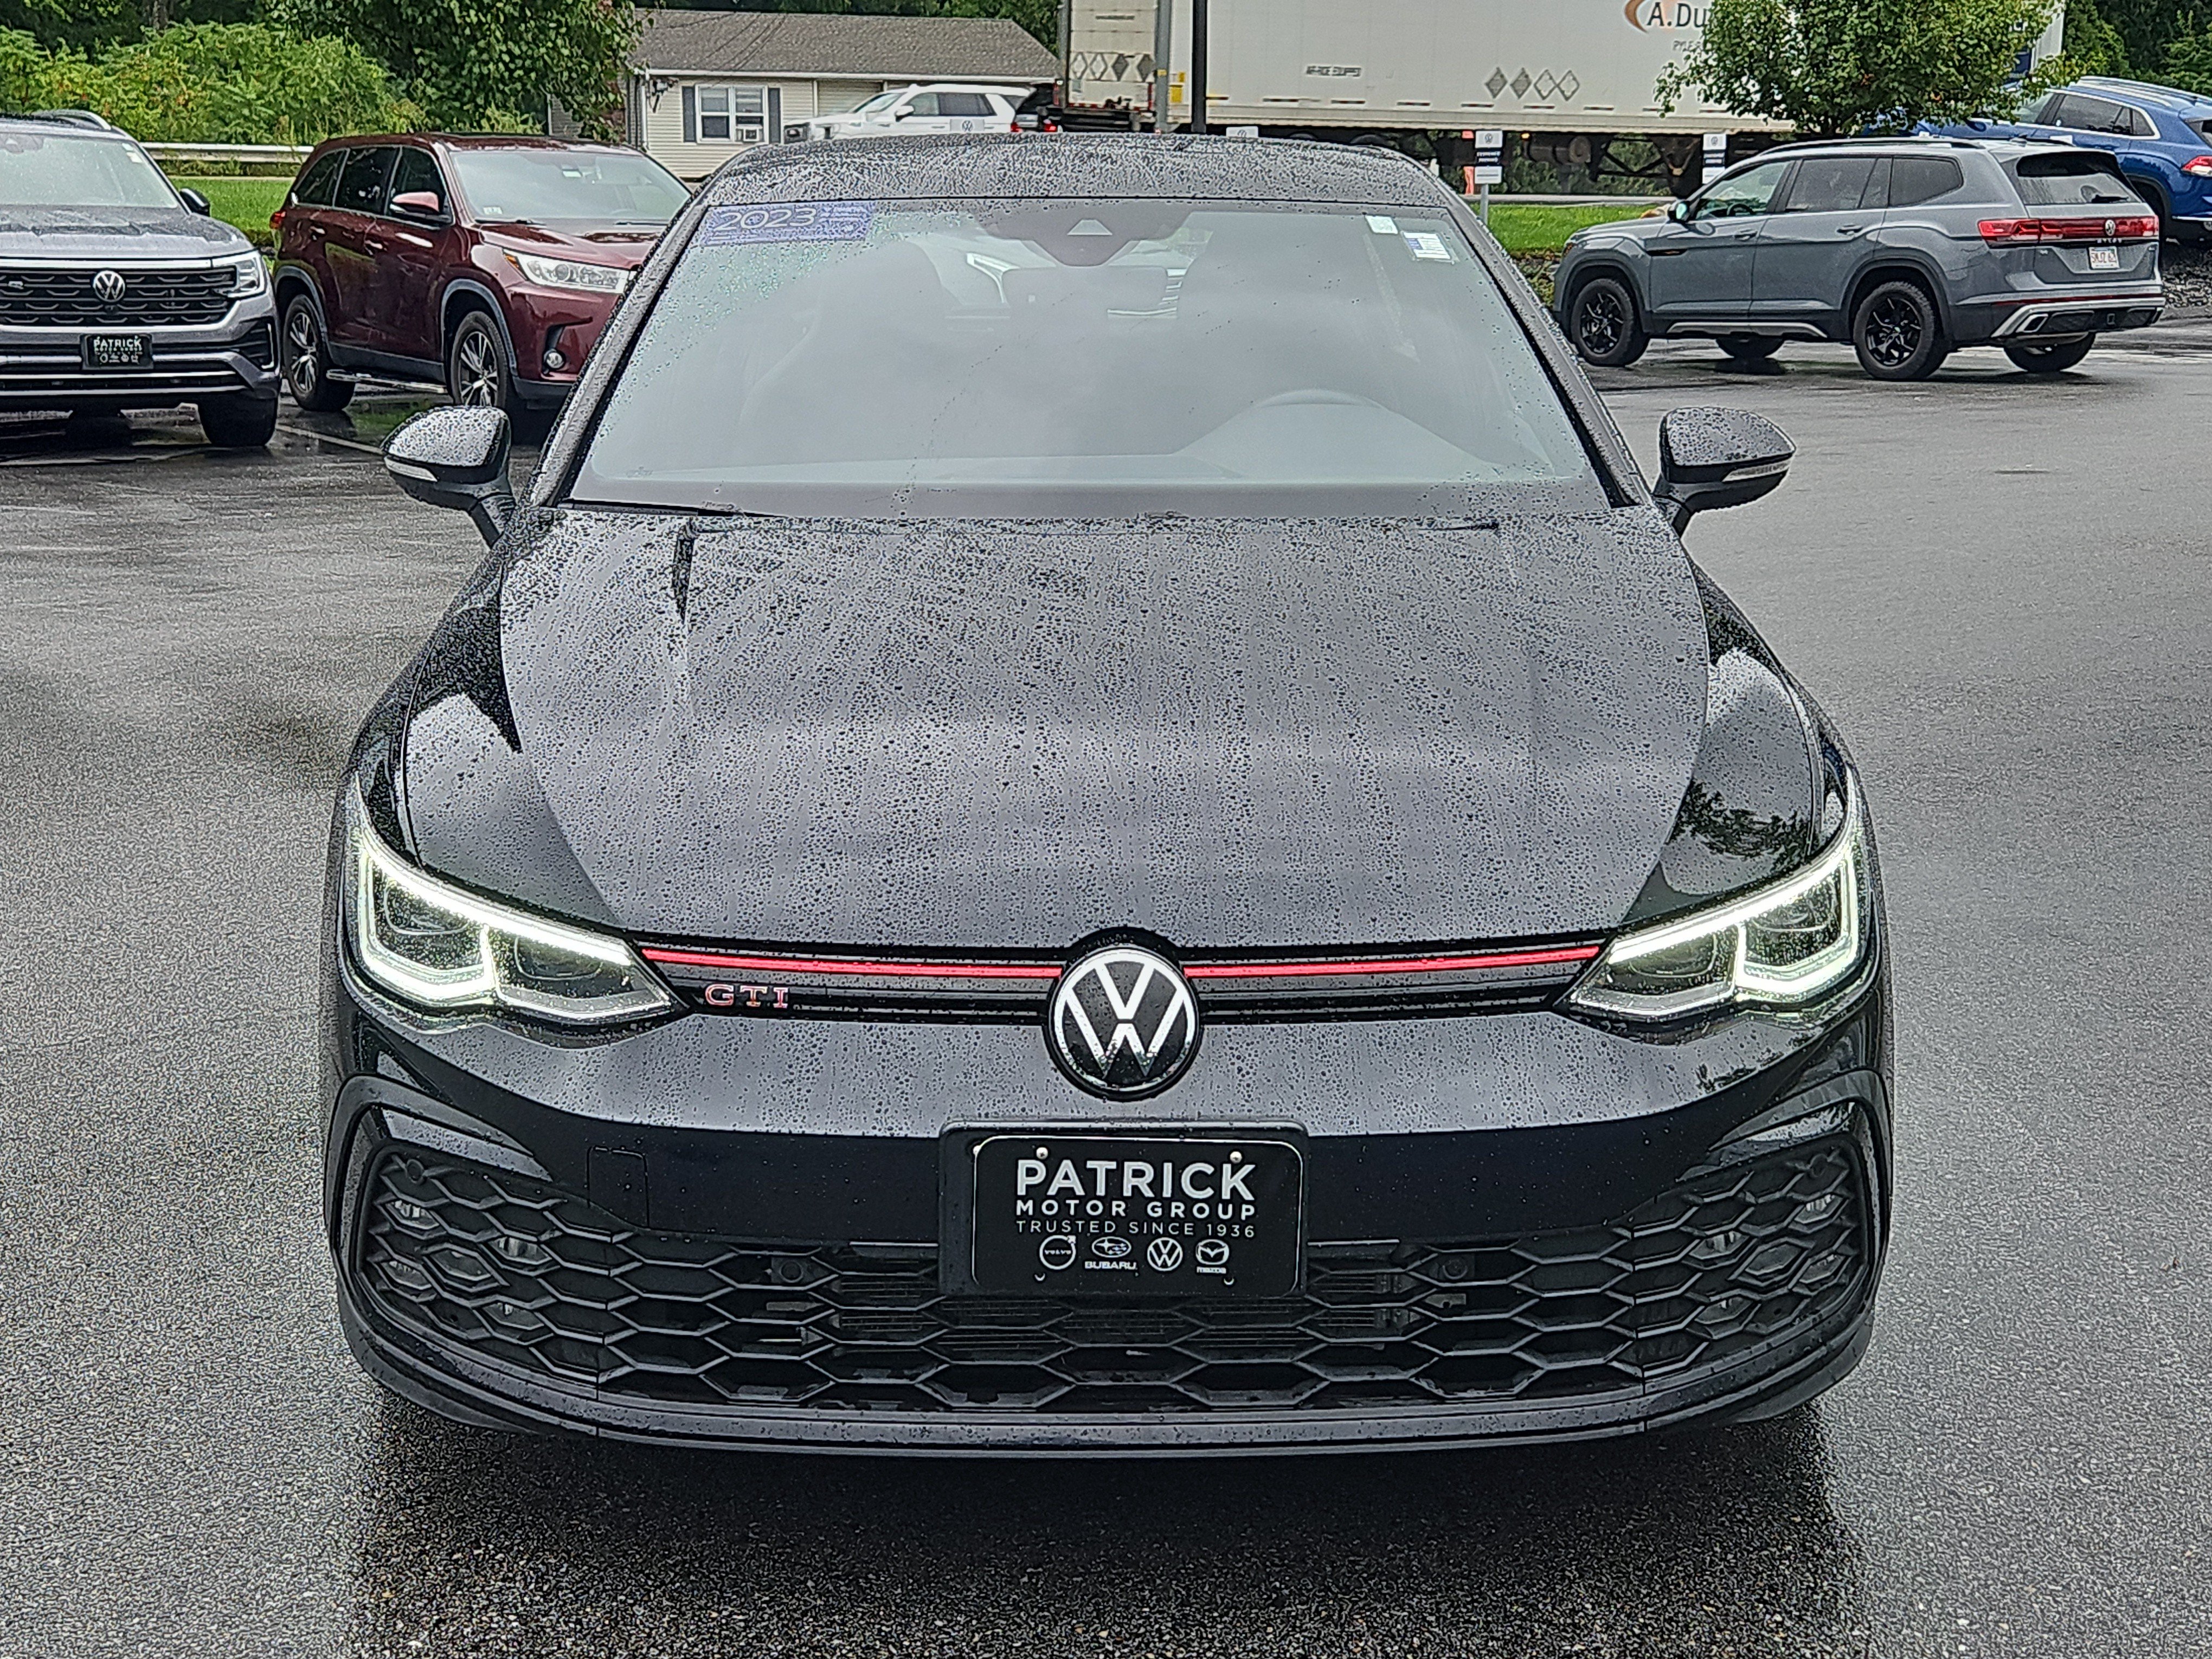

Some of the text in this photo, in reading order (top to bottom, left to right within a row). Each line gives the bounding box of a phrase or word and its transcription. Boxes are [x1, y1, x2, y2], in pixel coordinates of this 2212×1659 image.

[715, 207, 817, 231] 2023
[93, 338, 142, 349] PATRICK
[705, 984, 789, 1009] GTI
[1017, 1159, 1256, 1200] PATRICK
[1016, 1199, 1255, 1220] MOTOR GROUP
[1016, 1220, 1255, 1238] TRUSTED SINCE 1936
[1084, 1261, 1136, 1270] SUBARU
